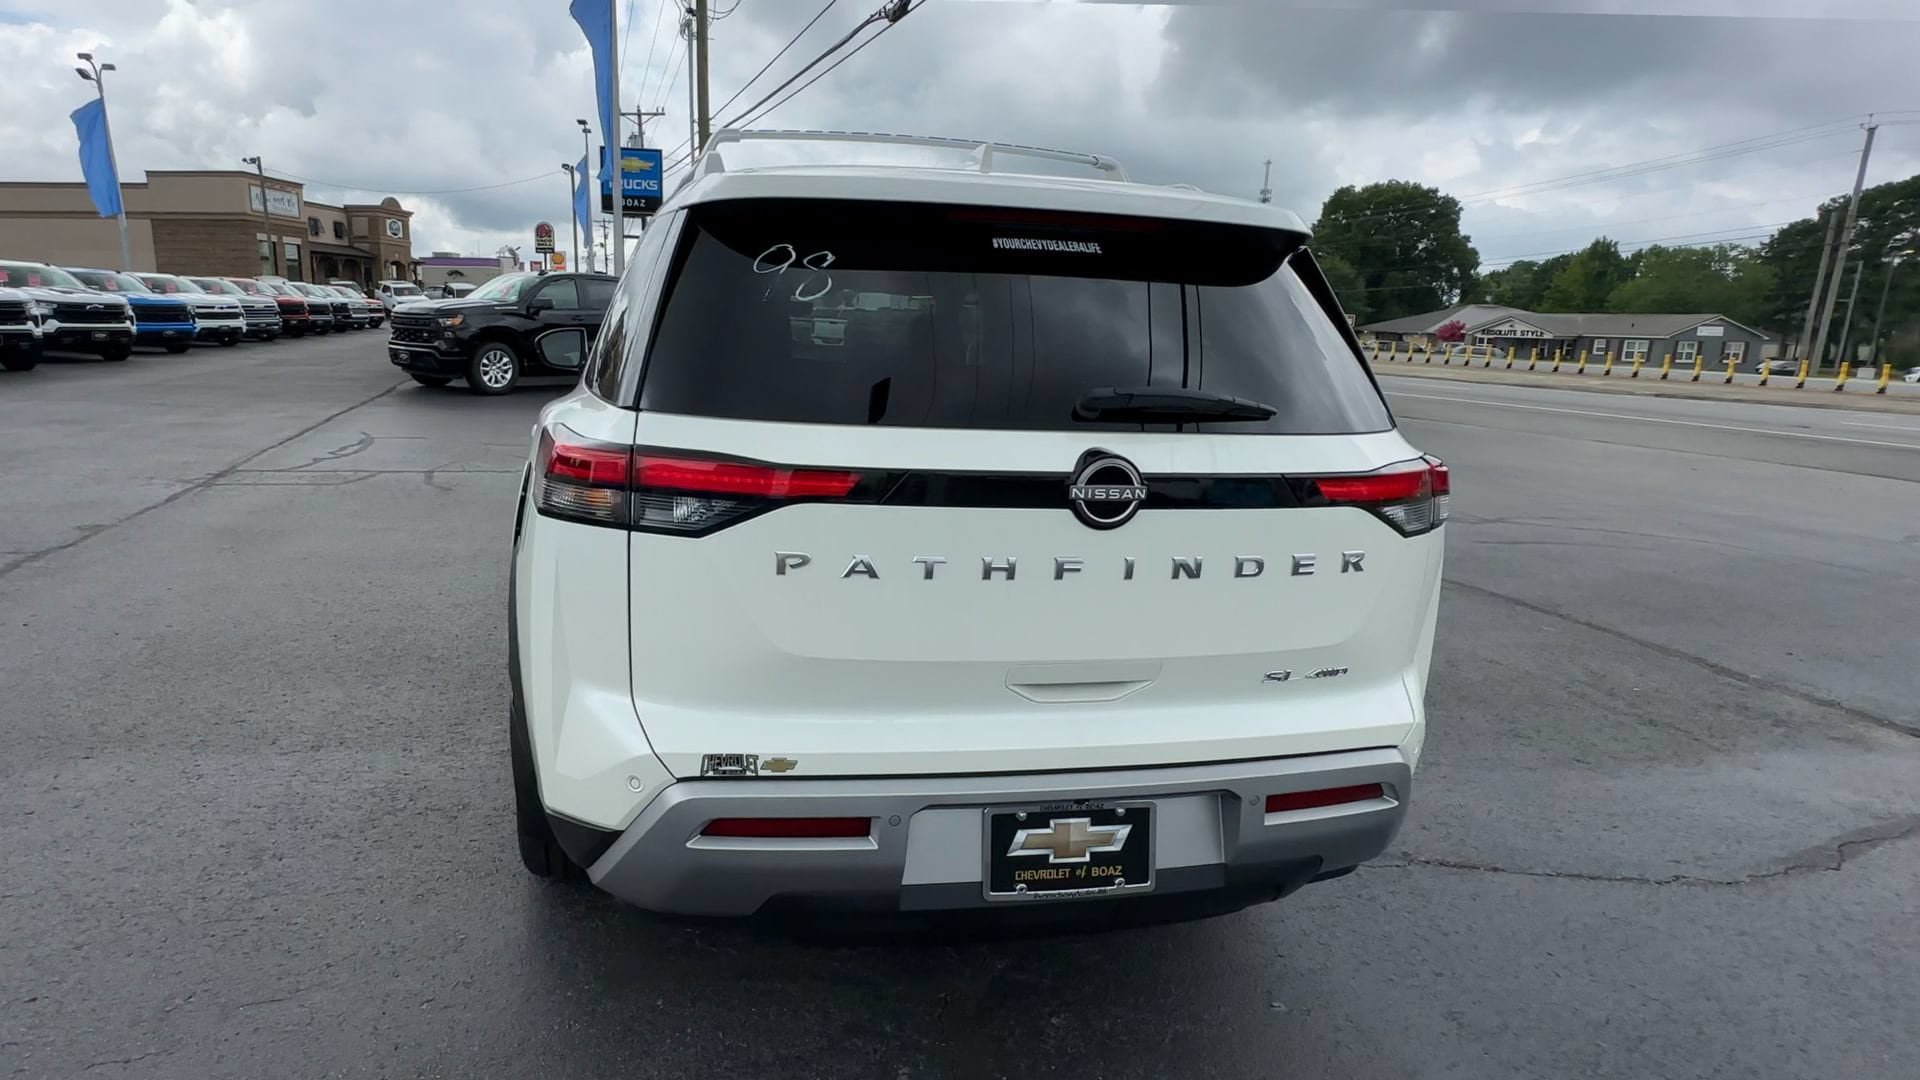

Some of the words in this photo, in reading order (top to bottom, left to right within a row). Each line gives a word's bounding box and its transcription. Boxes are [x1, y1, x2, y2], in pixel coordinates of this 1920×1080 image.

[992, 238, 1102, 254] #YOURCHEVYDEALER4LIFE
[753, 243, 836, 301] 98
[1481, 329, 1518, 337] ABSOLUTE
[1072, 488, 1146, 499] NISSAN
[775, 550, 1367, 581] PATHFINDER
[701, 753, 759, 776] CHEVROLET
[1015, 868, 1071, 881] CHEVROLET
[1076, 866, 1088, 877] of
[1091, 866, 1123, 877] BOAZ
